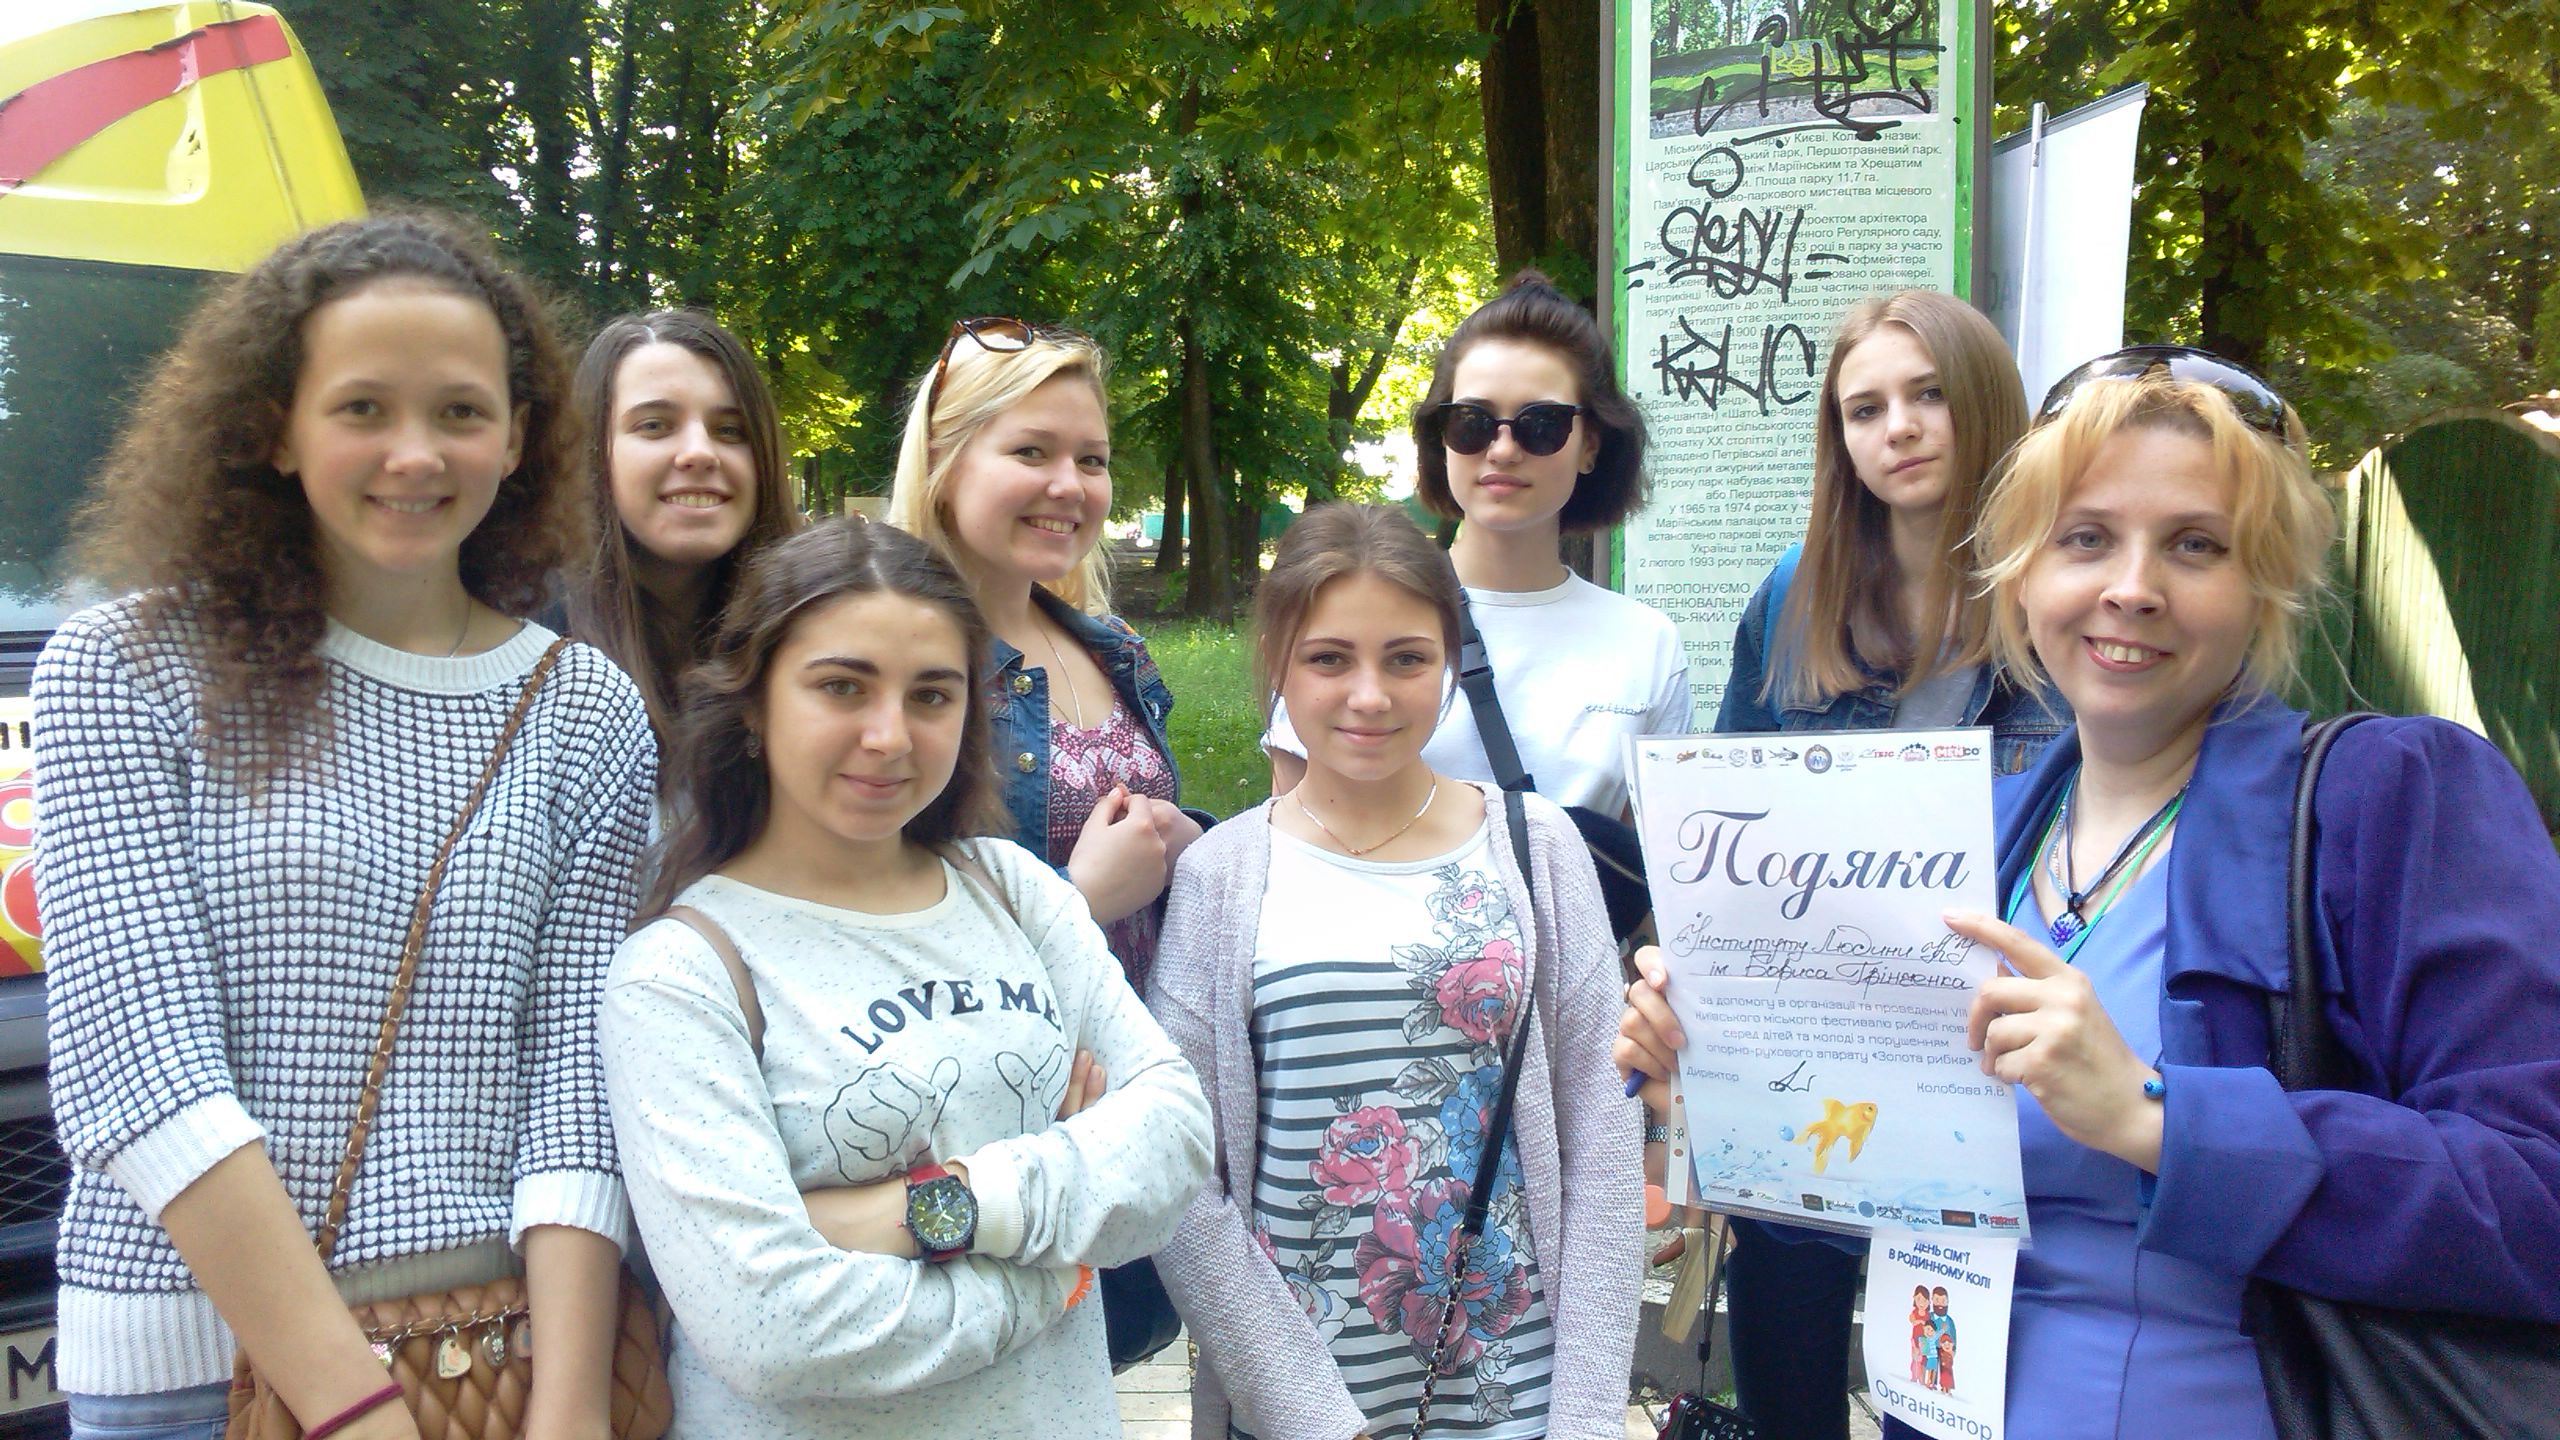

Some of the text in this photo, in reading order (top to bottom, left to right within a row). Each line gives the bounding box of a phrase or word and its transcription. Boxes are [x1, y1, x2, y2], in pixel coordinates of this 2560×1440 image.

[1884, 131, 1921, 141] назви:
[1806, 144, 1910, 157] Першотравневий
[1845, 159, 1858, 168] та
[1861, 157, 1923, 170] Хрещатим
[1755, 176, 1797, 187] Площа
[1799, 175, 1834, 186] парку
[1864, 175, 1880, 183] га.
[1809, 186, 1872, 198] мистецтва
[1875, 184, 1932, 197] місцевого
[1859, 213, 1928, 225] архітектора
[1836, 226, 1910, 238] Регулярного
[1779, 242, 1807, 253] 163
[1810, 241, 1835, 254] році
[1848, 242, 1881, 253] парку
[1884, 242, 1898, 250] за
[1901, 241, 1943, 252] участю
[1869, 268, 1935, 280] оранжереї.
[1821, 282, 1869, 293] частина
[1645, 307, 1675, 318] парку
[1678, 302, 1741, 315] переходить
[1744, 301, 1759, 310] до
[1737, 314, 1762, 324] стає
[1765, 311, 1820, 323] закритою
[1657, 425, 1682, 437] було
[1685, 422, 1733, 436] відкрито
[1663, 438, 1705, 450] початку
[1726, 434, 1773, 446] століття
[1712, 447, 1778, 461] Петрівської
[1781, 446, 1807, 457] алеї
[1715, 462, 1764, 476] ажурний
[1671, 478, 1695, 489] року
[1698, 477, 1723, 488] парк
[1726, 475, 1773, 487] набуває
[1776, 474, 1808, 486] назву
[1705, 490, 1726, 500] або
[1680, 504, 1705, 514] 1965
[1709, 505, 1721, 513] та
[1725, 503, 1750, 513] 1974
[1754, 504, 1787, 515] роках
[1790, 504, 1798, 513] у
[1726, 516, 1776, 528] палацом
[1780, 516, 1792, 525] та
[1648, 531, 1716, 542] встановлено
[1719, 528, 1762, 541] паркові
[1691, 543, 1736, 554] Українці
[1740, 544, 1752, 553] та
[1639, 558, 1646, 568] 2
[1649, 559, 1685, 568] лютого
[1690, 556, 1714, 567] 1993
[1717, 558, 1741, 569] року
[1634, 582, 1750, 594] МИ ПРОПОНУЄМО
[1669, 807, 1970, 921] Подяка
[1699, 996, 1713, 1005] за
[1716, 997, 1775, 1010] допомогу
[1778, 1000, 1786, 1008] в
[1789, 999, 1856, 1011] організації
[1859, 1002, 1871, 1011] та
[1875, 1003, 1948, 1017] проведенні
[841, 980, 984, 1055] LOVE
[1763, 1013, 1818, 1026] міського
[1820, 1015, 1892, 1029] фестивалю
[1895, 1019, 1938, 1032] рибної
[1722, 1029, 1949, 1049] серед дітей та молоді з порушенням
[1706, 1043, 1813, 1059] опорно-рухового
[1871, 1050, 1923, 1064] «Золота
[1926, 1054, 1973, 1066] рибка»
[1686, 1066, 1740, 1082] Директор
[1916, 1081, 1980, 1096] Колобова
[1888, 1248, 1991, 1289] В РОДИННОМУ КОЛІ
[1875, 1379, 1993, 1440] Організатор
